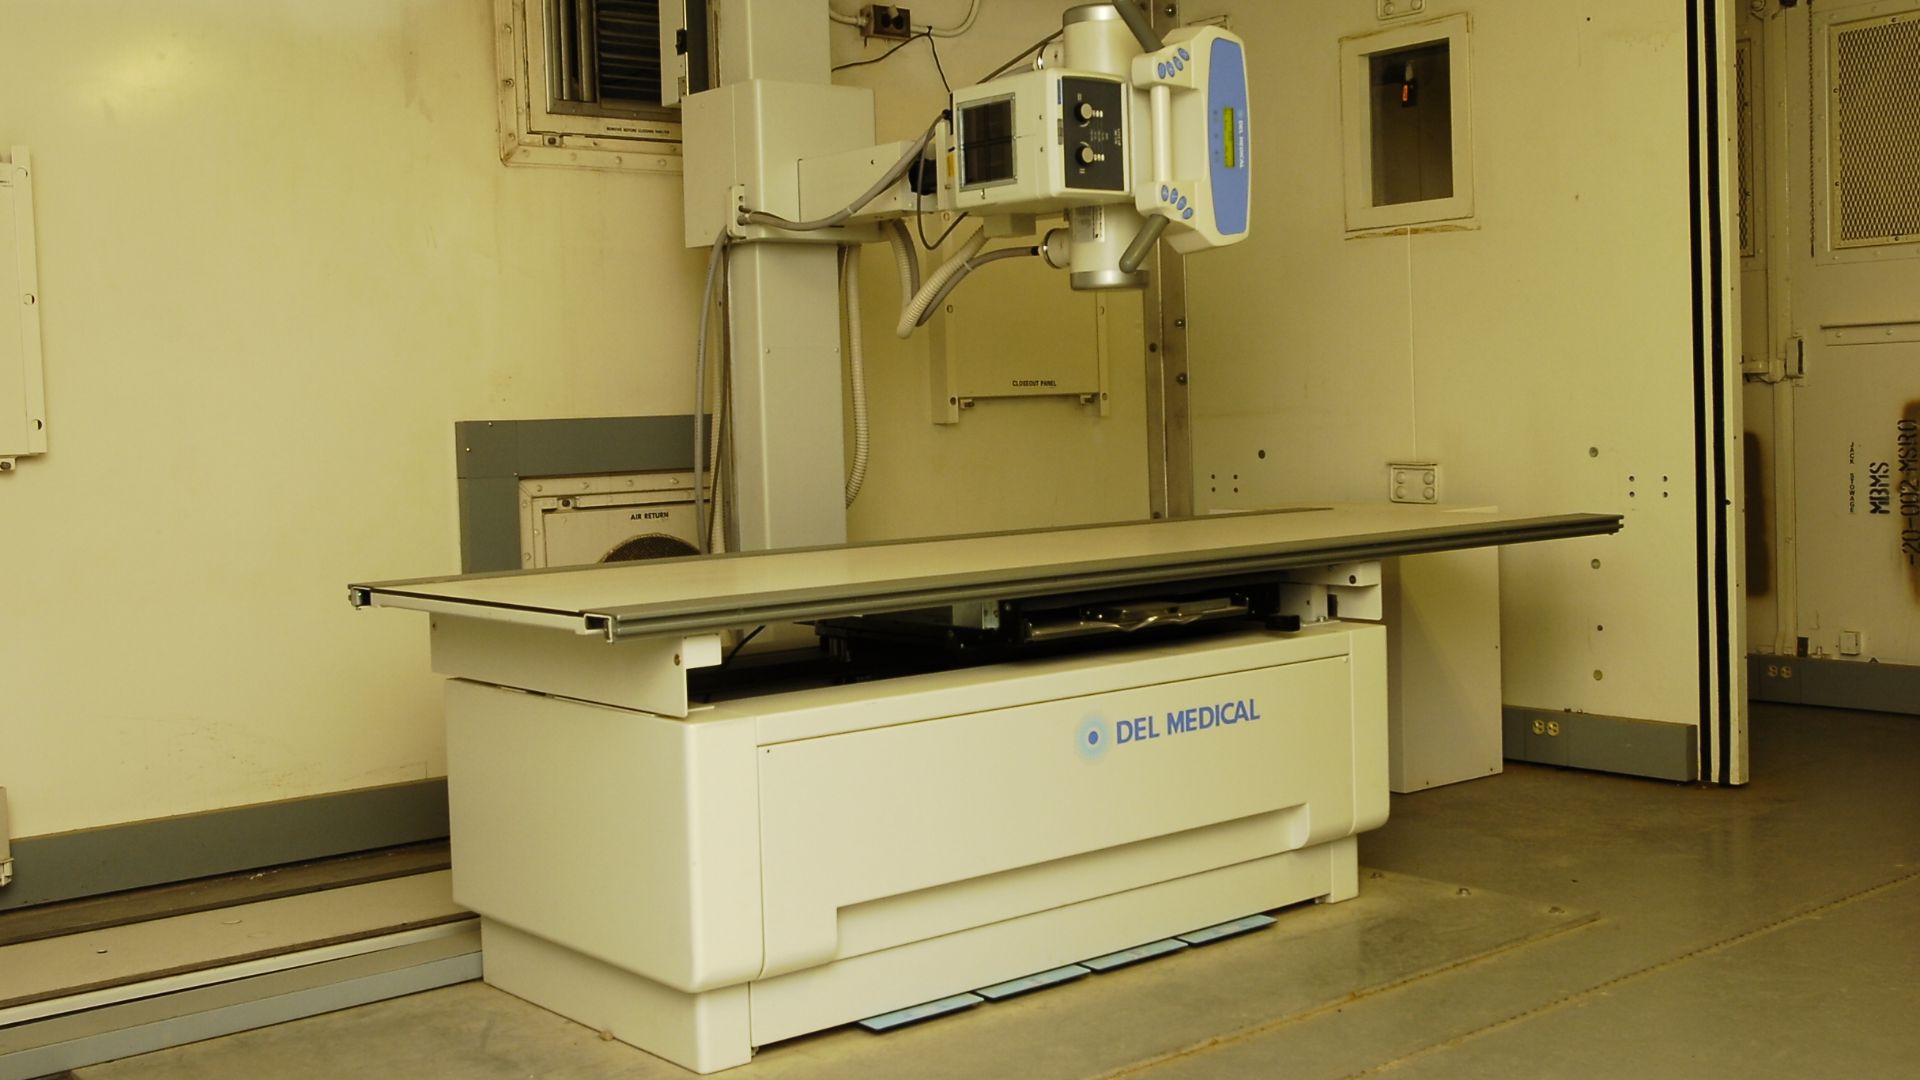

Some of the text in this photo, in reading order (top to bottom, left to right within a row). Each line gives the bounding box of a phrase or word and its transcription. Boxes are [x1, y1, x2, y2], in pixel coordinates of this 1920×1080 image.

[1869, 461, 1890, 514] MBMS
[630, 511, 669, 521] AIR RETURN
[1116, 698, 1261, 745] DEL MEDICAL
